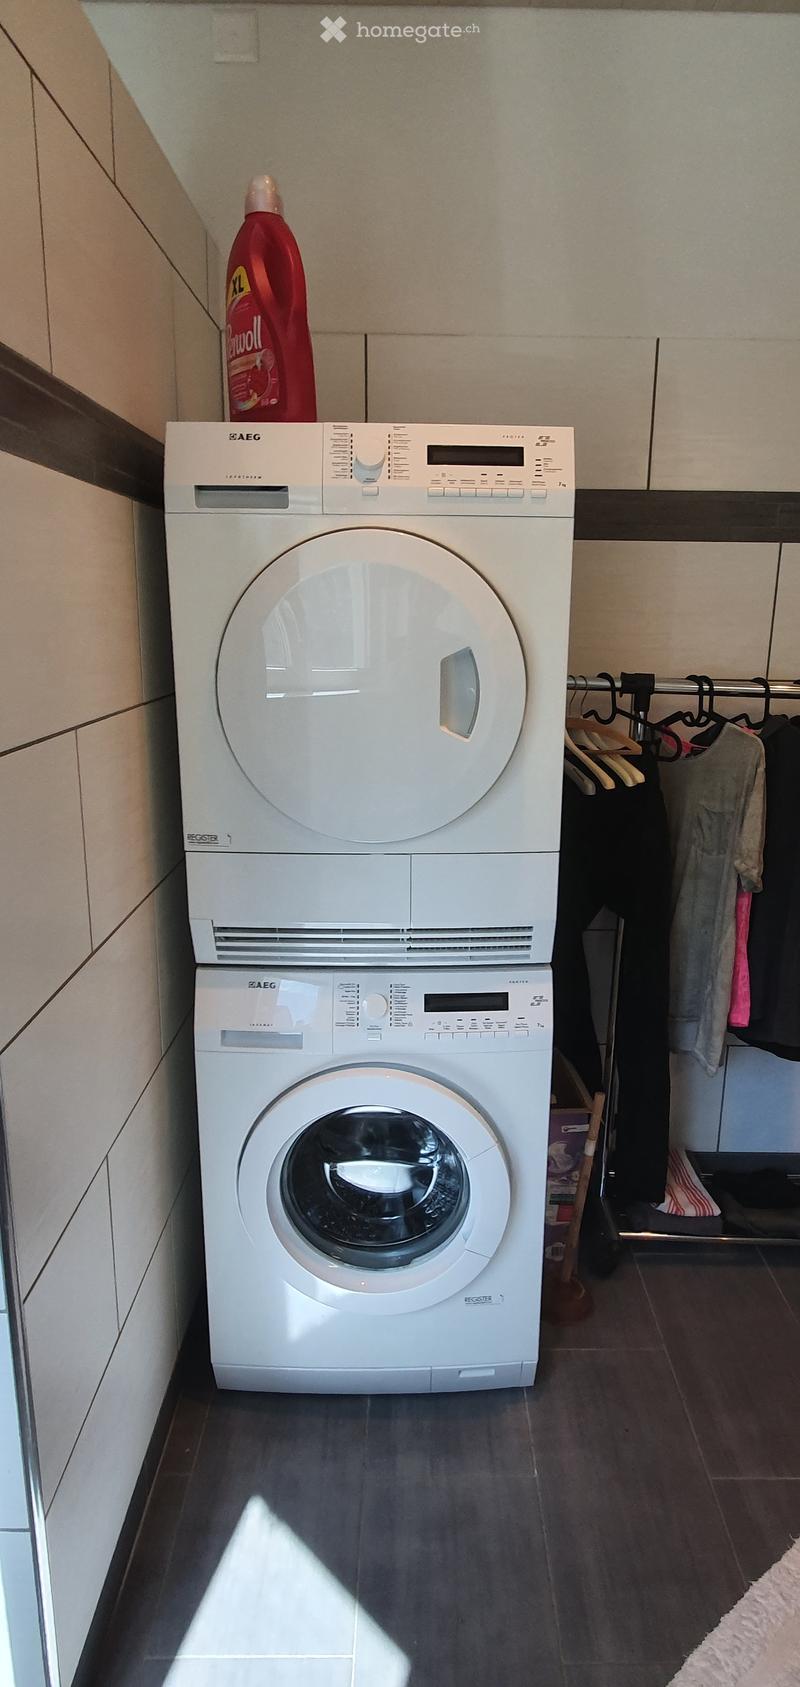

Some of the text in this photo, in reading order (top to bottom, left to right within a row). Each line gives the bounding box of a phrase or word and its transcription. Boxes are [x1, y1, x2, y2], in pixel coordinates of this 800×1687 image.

[231, 275, 245, 298] XL
[237, 433, 261, 441] AEG
[255, 981, 276, 989] AEG
